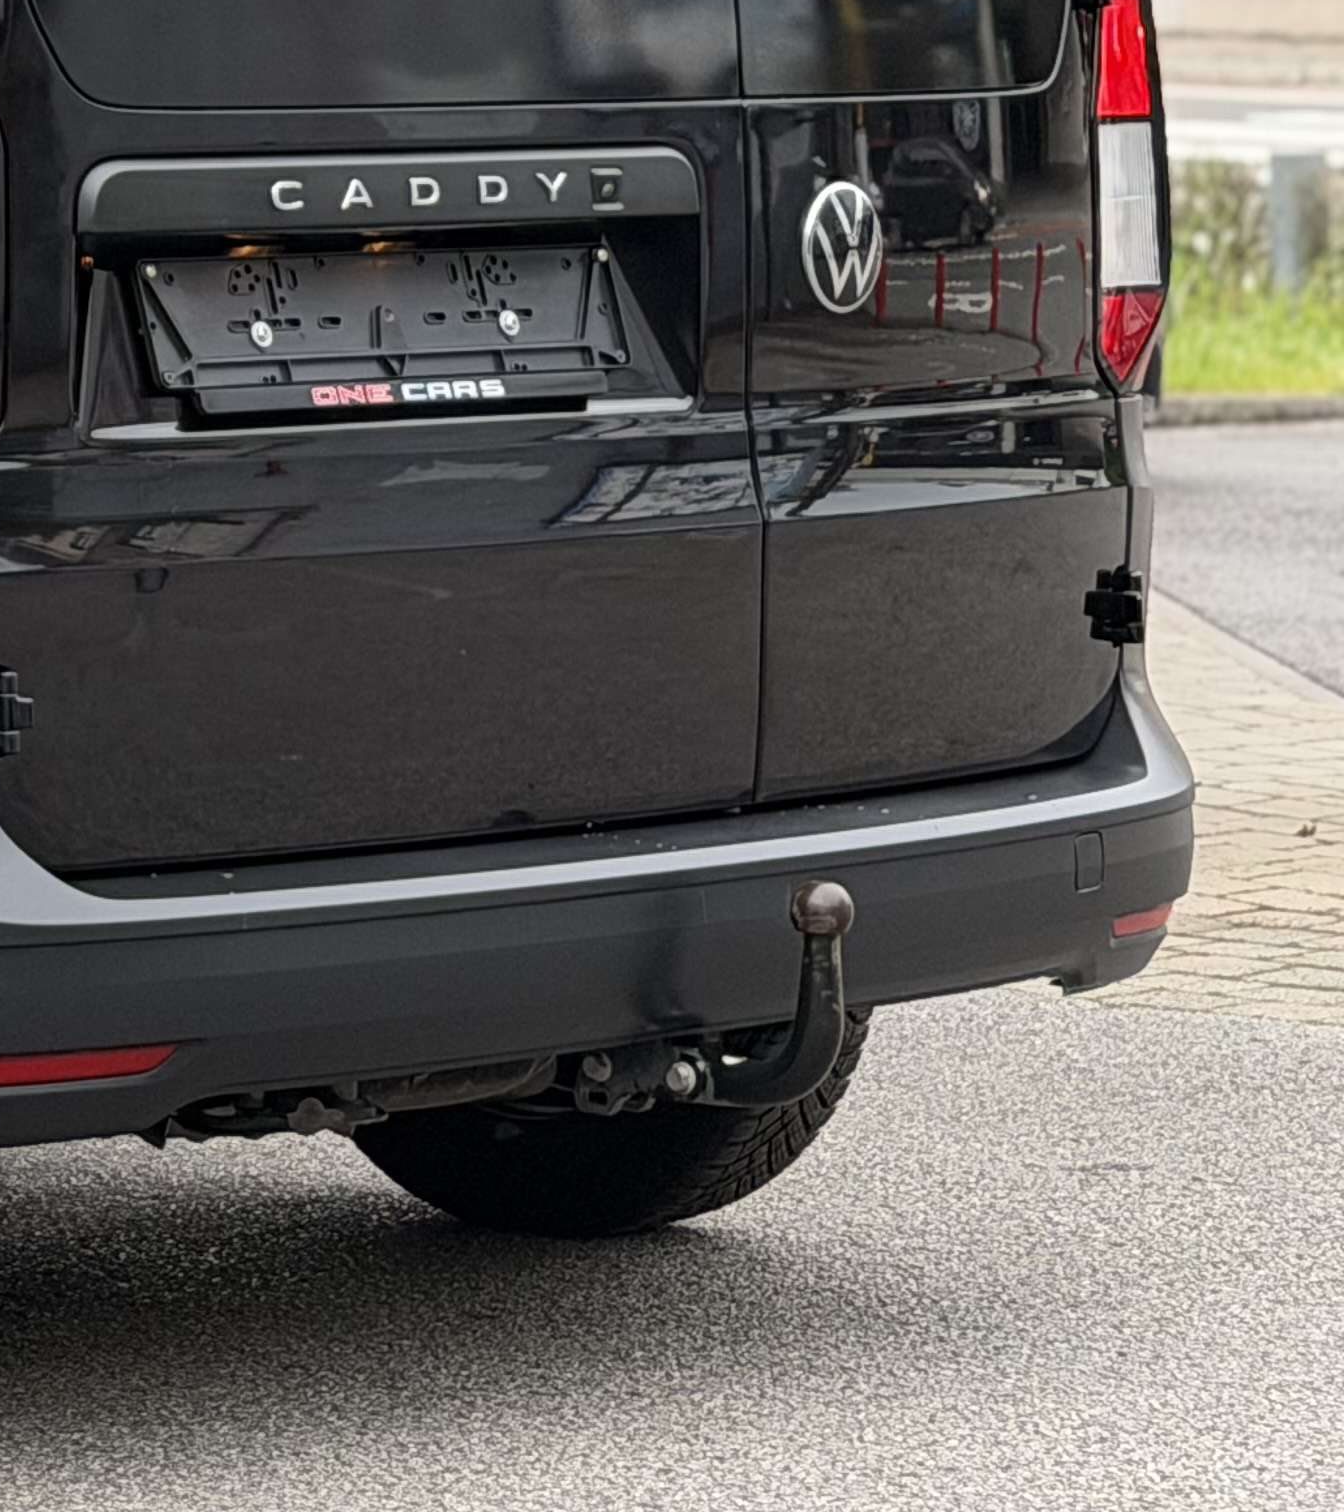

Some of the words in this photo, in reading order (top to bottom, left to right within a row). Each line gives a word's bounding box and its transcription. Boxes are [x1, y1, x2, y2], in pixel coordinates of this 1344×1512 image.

[269, 172, 568, 210] CADDY
[310, 383, 395, 407] ONE
[401, 378, 505, 400] CARS
